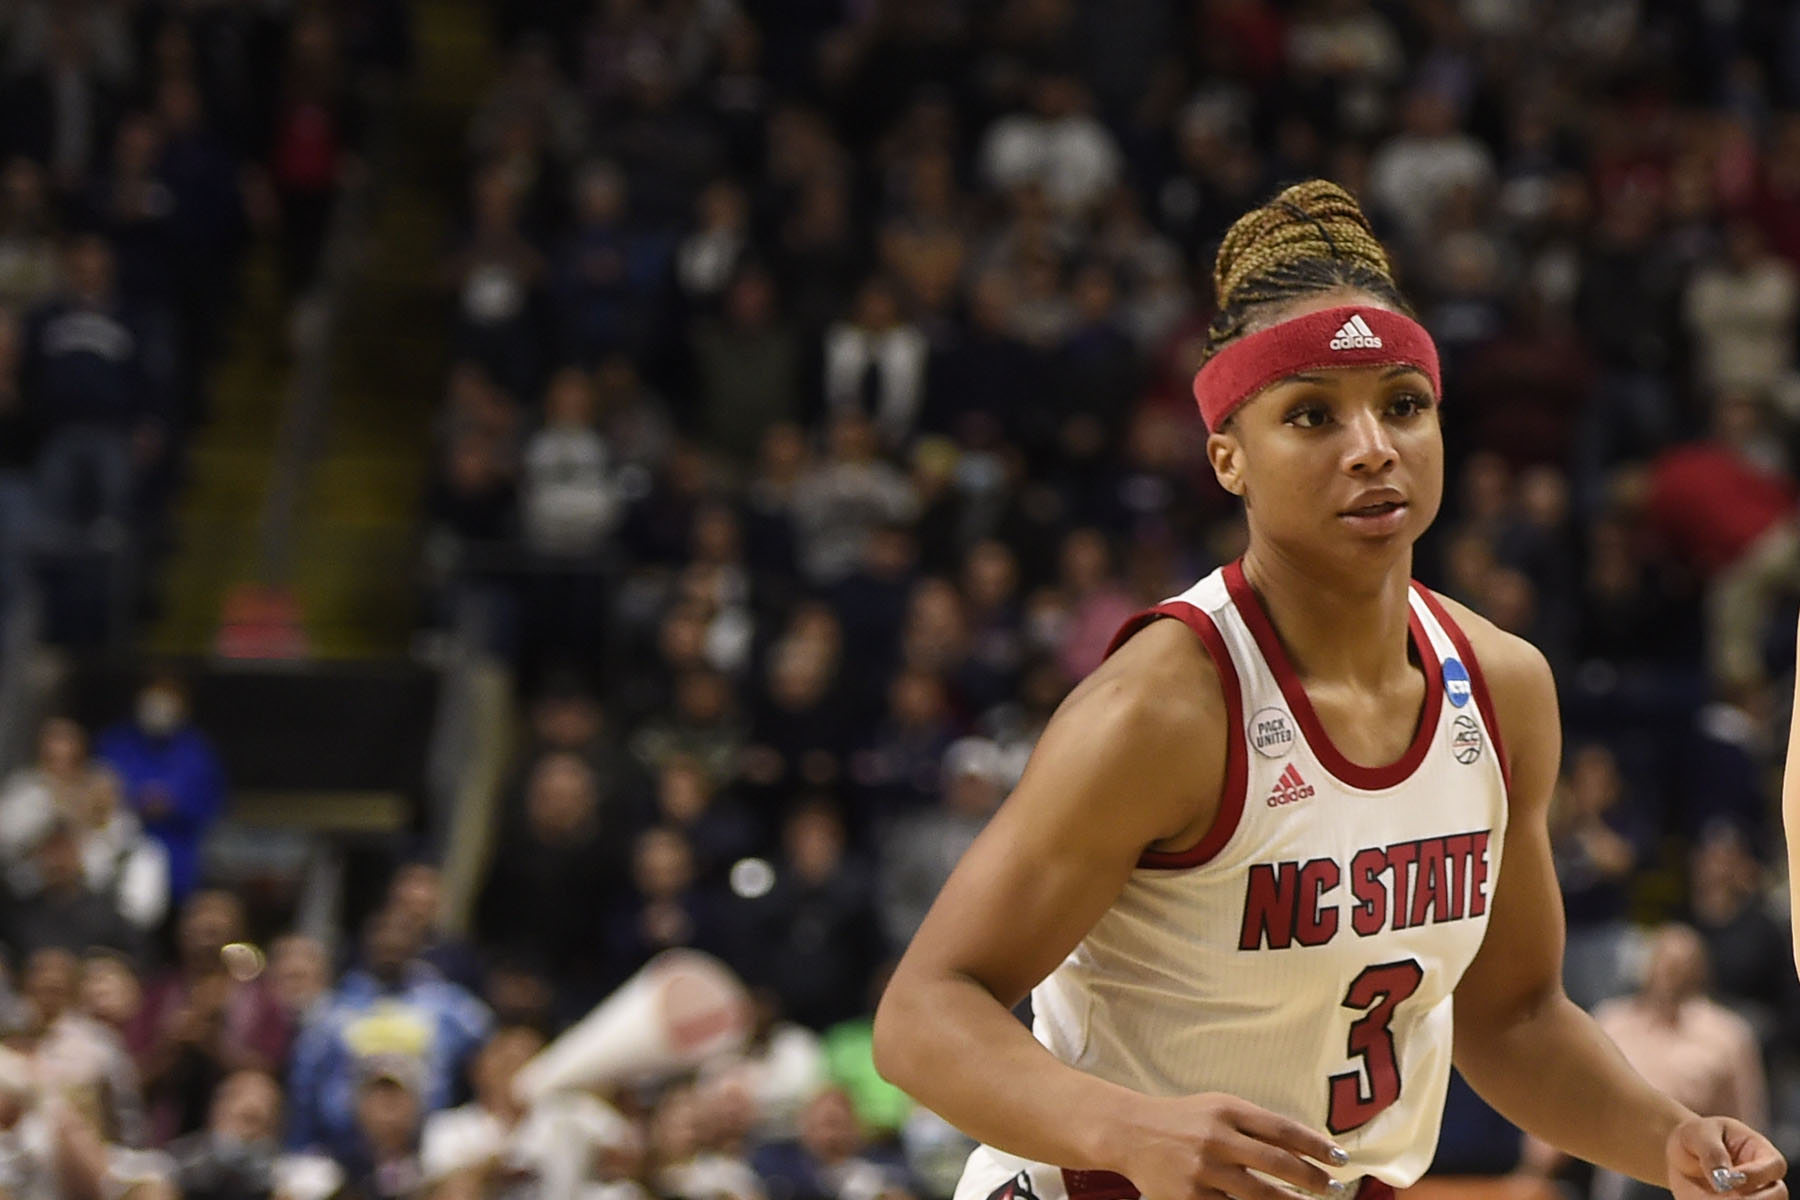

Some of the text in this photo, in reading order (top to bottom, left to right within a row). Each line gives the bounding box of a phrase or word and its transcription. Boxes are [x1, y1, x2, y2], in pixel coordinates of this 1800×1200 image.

[1330, 336, 1382, 351] adidas
[1258, 718, 1285, 735] PACK
[1257, 730, 1292, 748] UNITED
[1267, 785, 1315, 807] adidas
[1238, 829, 1491, 951] NC STATE
[1326, 957, 1424, 1136] 3
